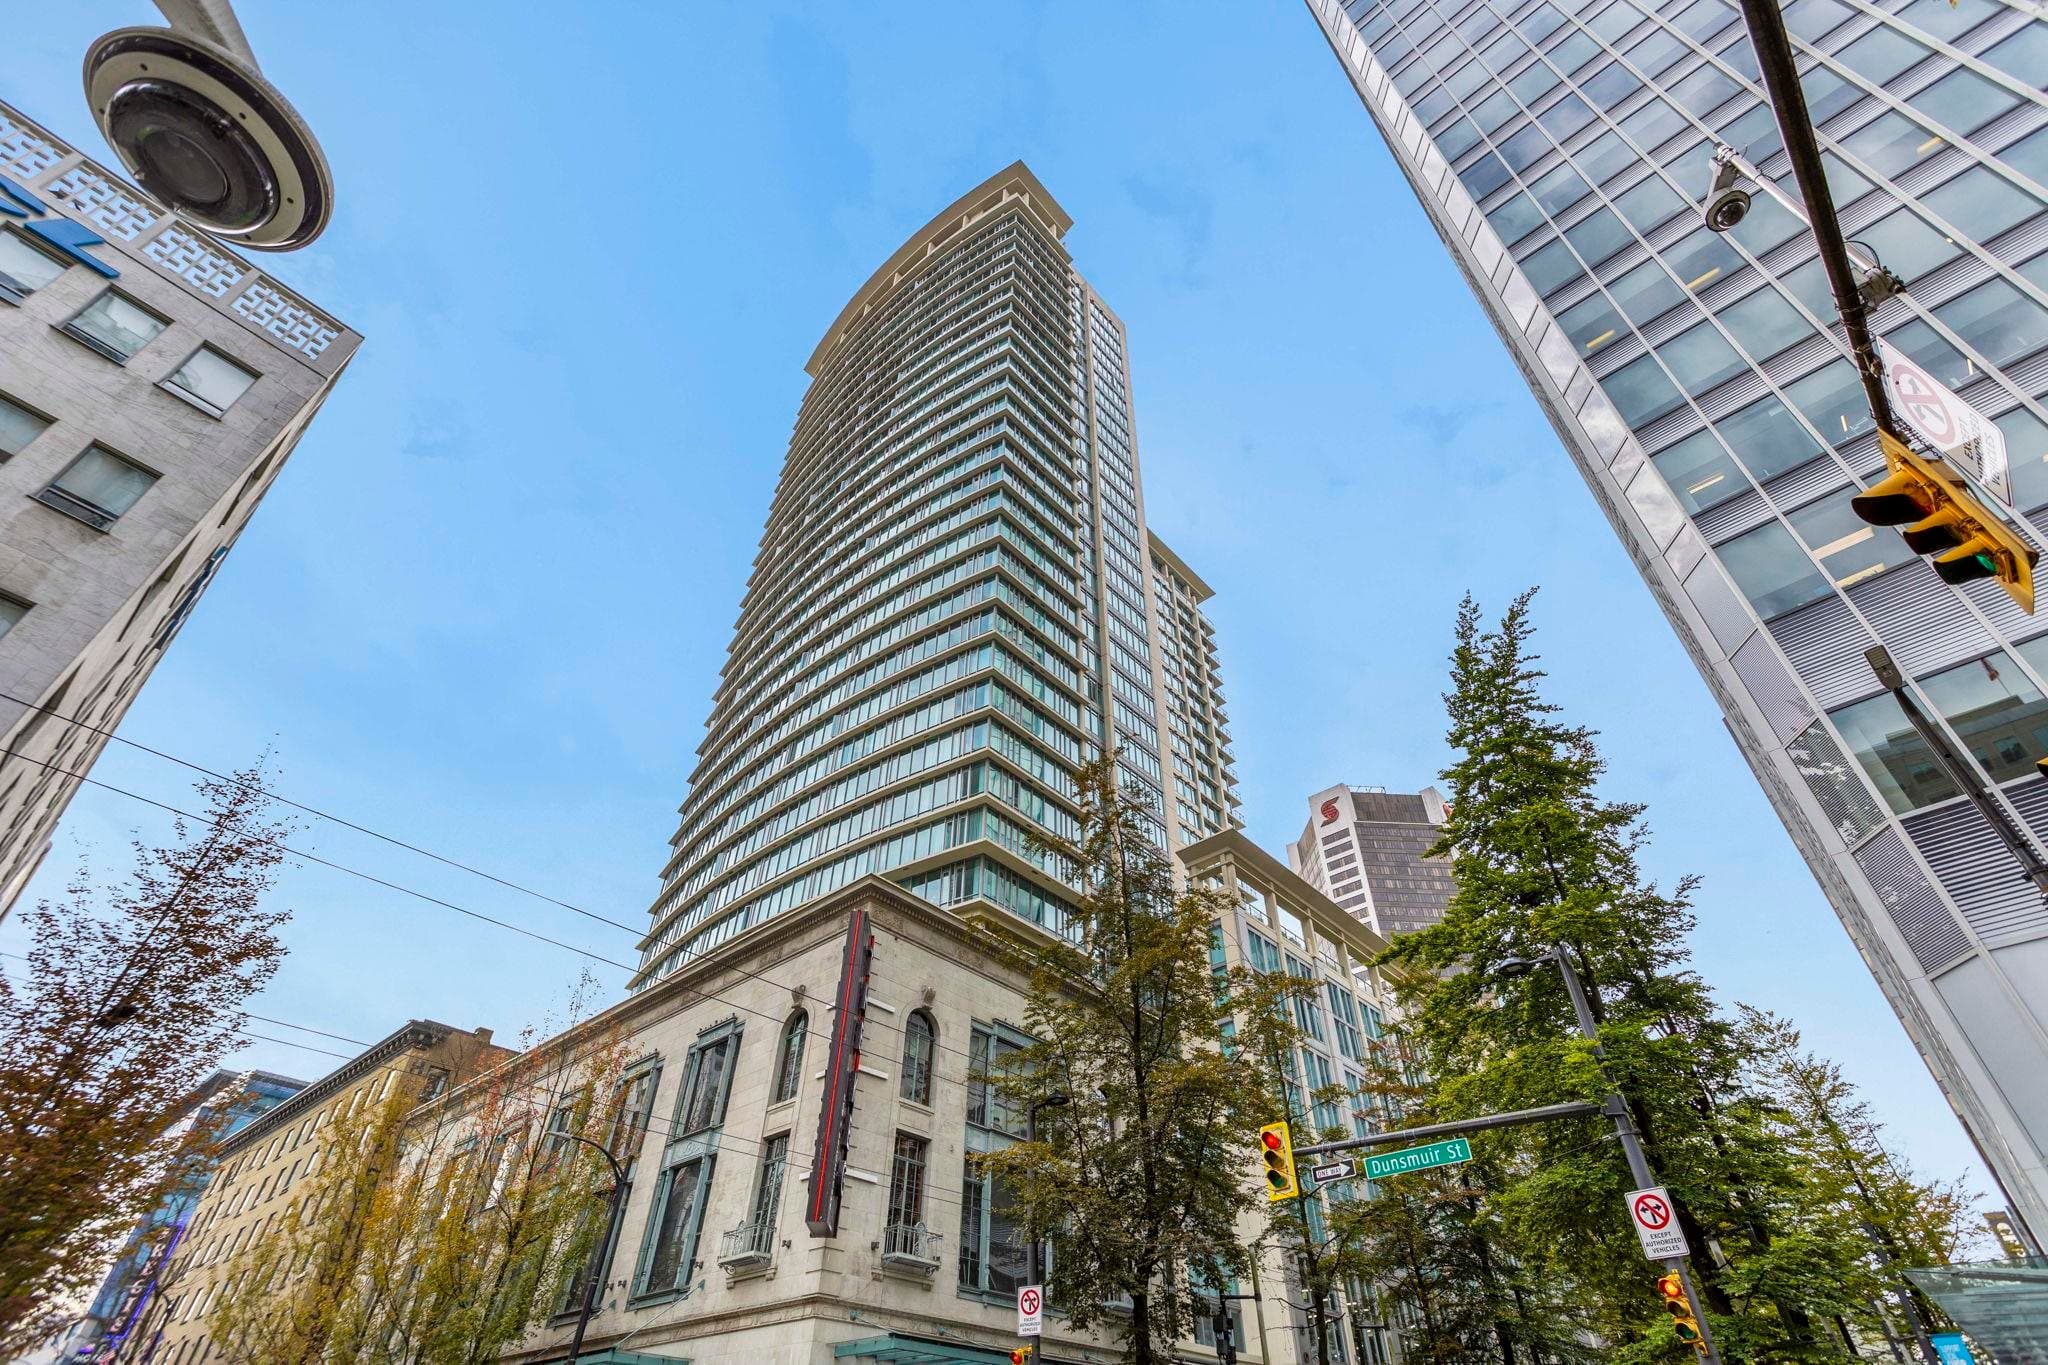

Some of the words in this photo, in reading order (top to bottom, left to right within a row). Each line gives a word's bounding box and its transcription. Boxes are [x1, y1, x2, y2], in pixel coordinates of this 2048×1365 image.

[1372, 1148, 1440, 1174] Dunsmuir
[1447, 1143, 1463, 1160] St
[1317, 1170, 1329, 1178] ONE
[1330, 1167, 1341, 1175] WAY
[1650, 1231, 1671, 1239] EXCEPT
[1646, 1237, 1681, 1247] AUTHORIZED
[1652, 1245, 1680, 1253] VEHICLES
